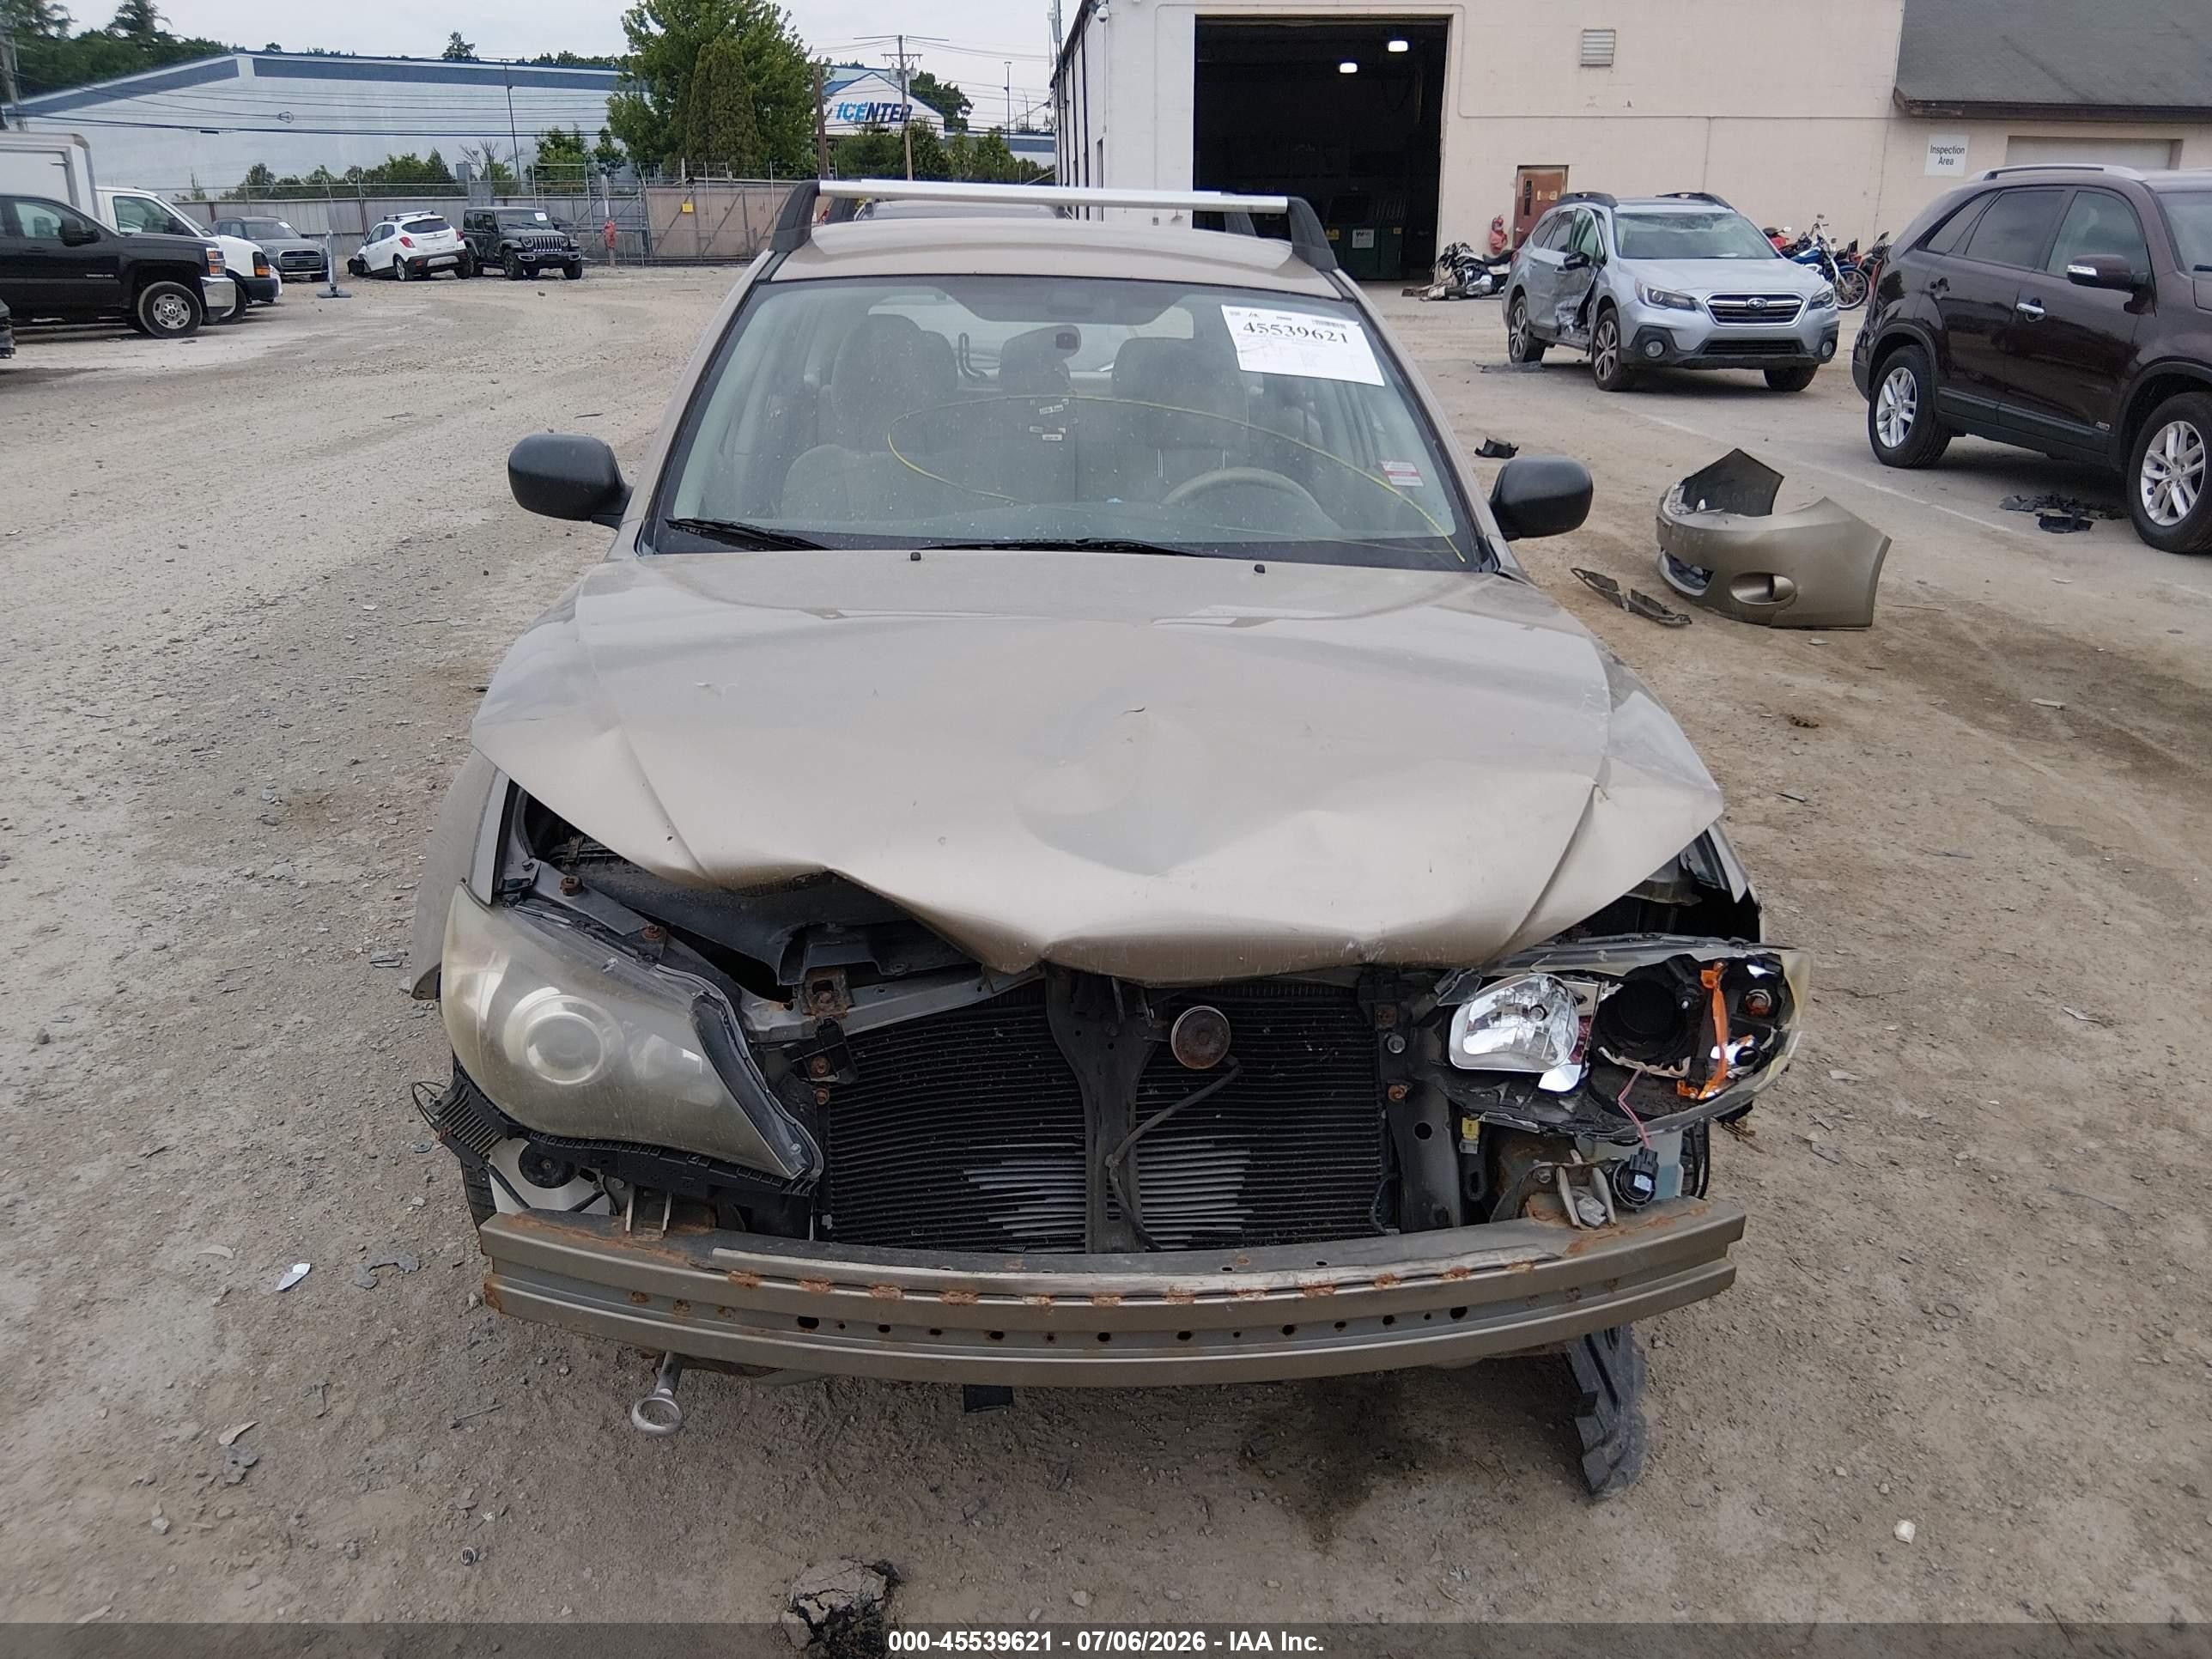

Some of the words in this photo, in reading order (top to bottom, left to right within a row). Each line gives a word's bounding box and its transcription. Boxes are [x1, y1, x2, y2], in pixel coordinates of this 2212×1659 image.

[1929, 144, 1966, 155] Inspection
[1937, 155, 1954, 166] Area
[1243, 322, 1348, 344] 45539621
